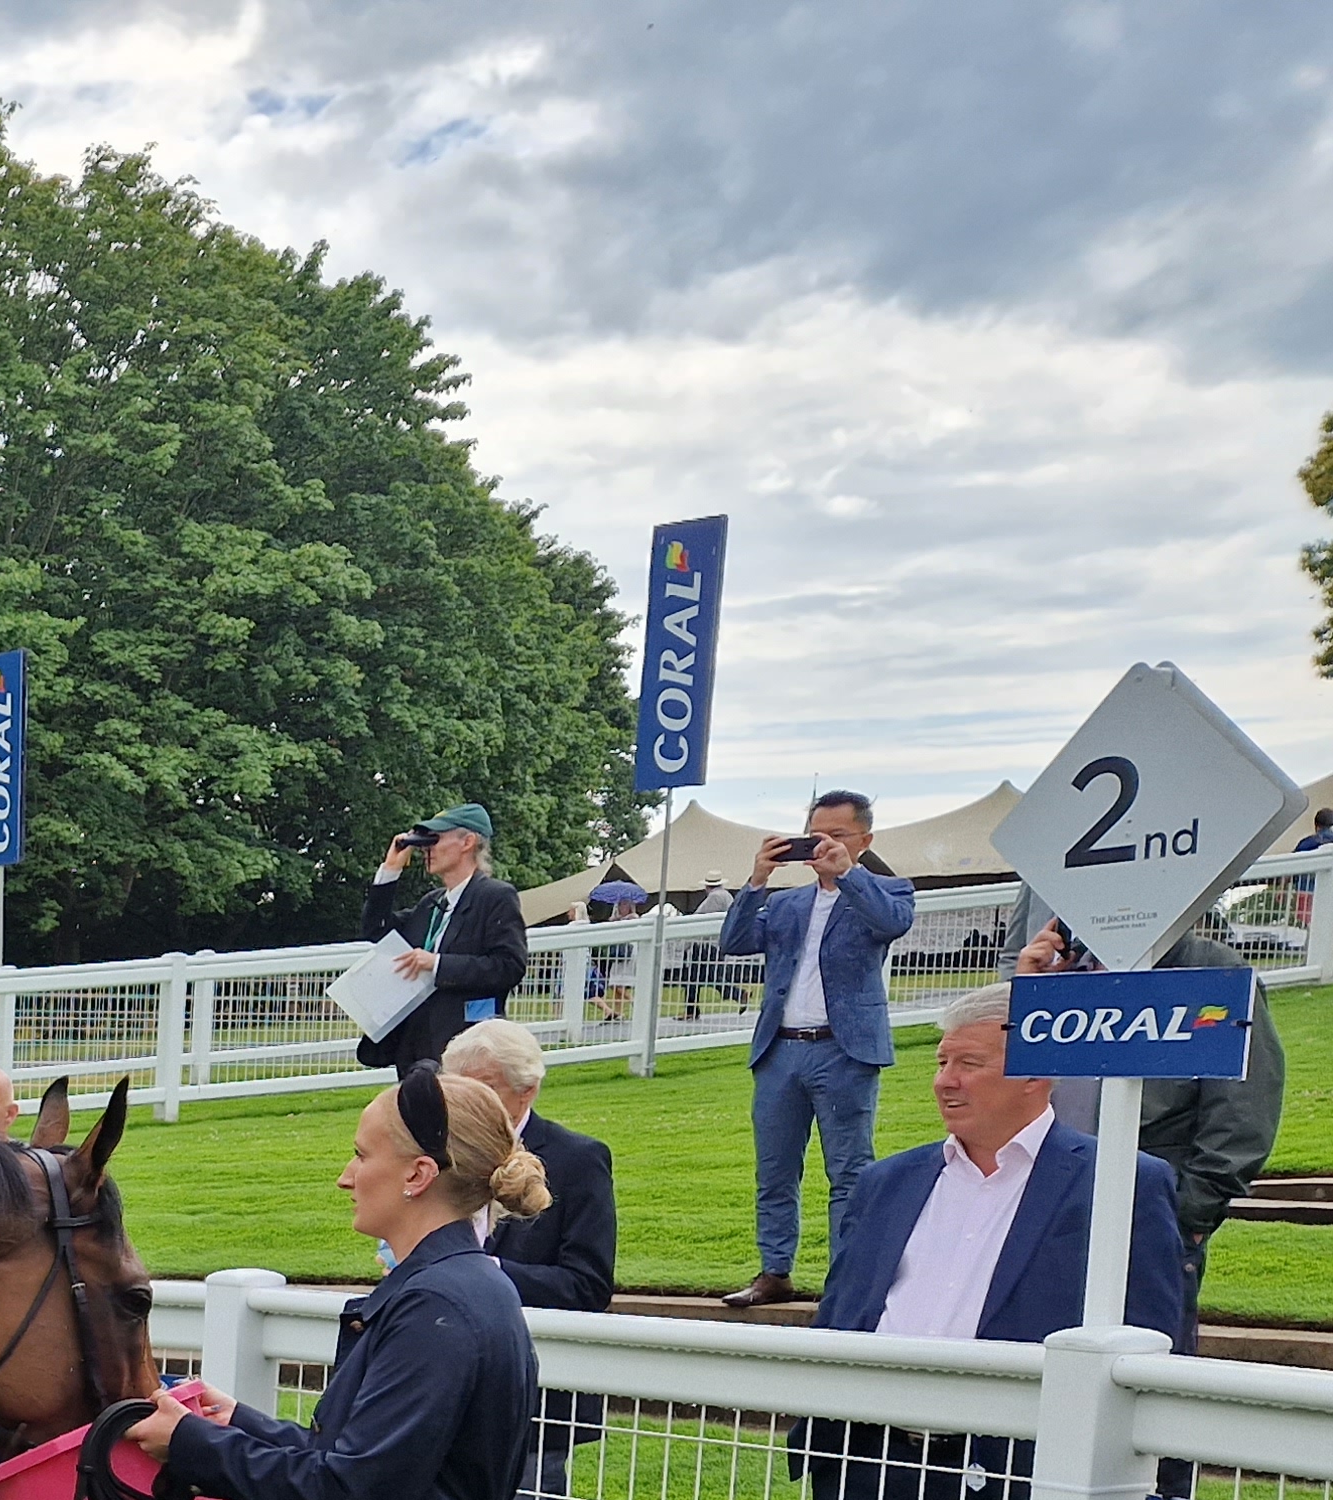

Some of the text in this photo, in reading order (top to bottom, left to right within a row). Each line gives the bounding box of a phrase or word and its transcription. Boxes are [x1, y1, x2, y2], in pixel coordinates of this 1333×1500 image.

[653, 571, 702, 774] CORAL
[1090, 911, 1158, 925] THE JOCKEY CLUB
[1020, 1006, 1193, 1044] CORAL
